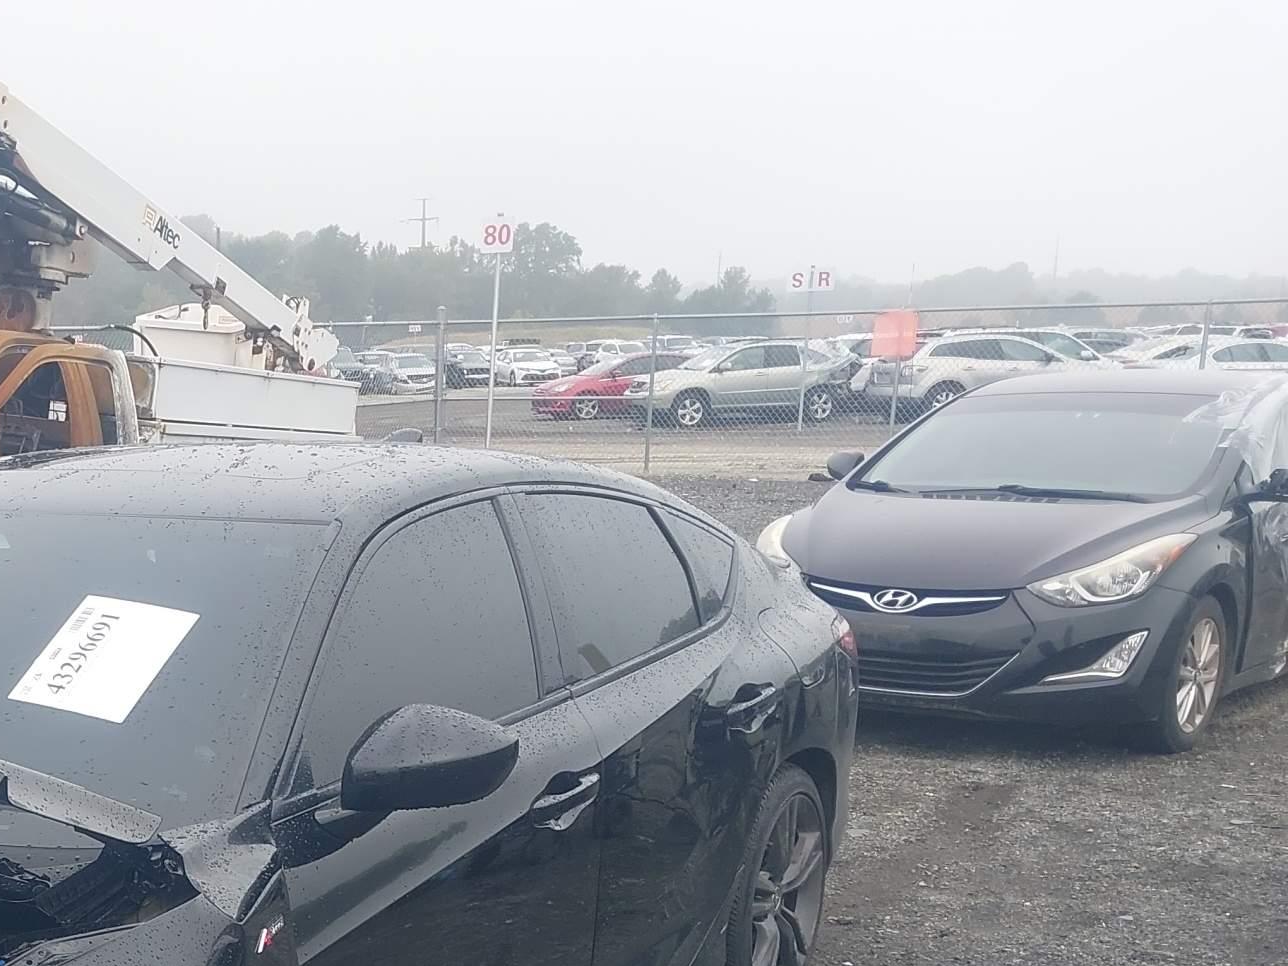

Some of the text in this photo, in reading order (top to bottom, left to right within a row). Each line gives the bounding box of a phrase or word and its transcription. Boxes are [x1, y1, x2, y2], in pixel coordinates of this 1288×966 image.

[153, 215, 181, 249] Altec
[483, 223, 511, 246] 80
[791, 272, 804, 288] S
[817, 271, 831, 287] R
[47, 613, 120, 695] 43296691
